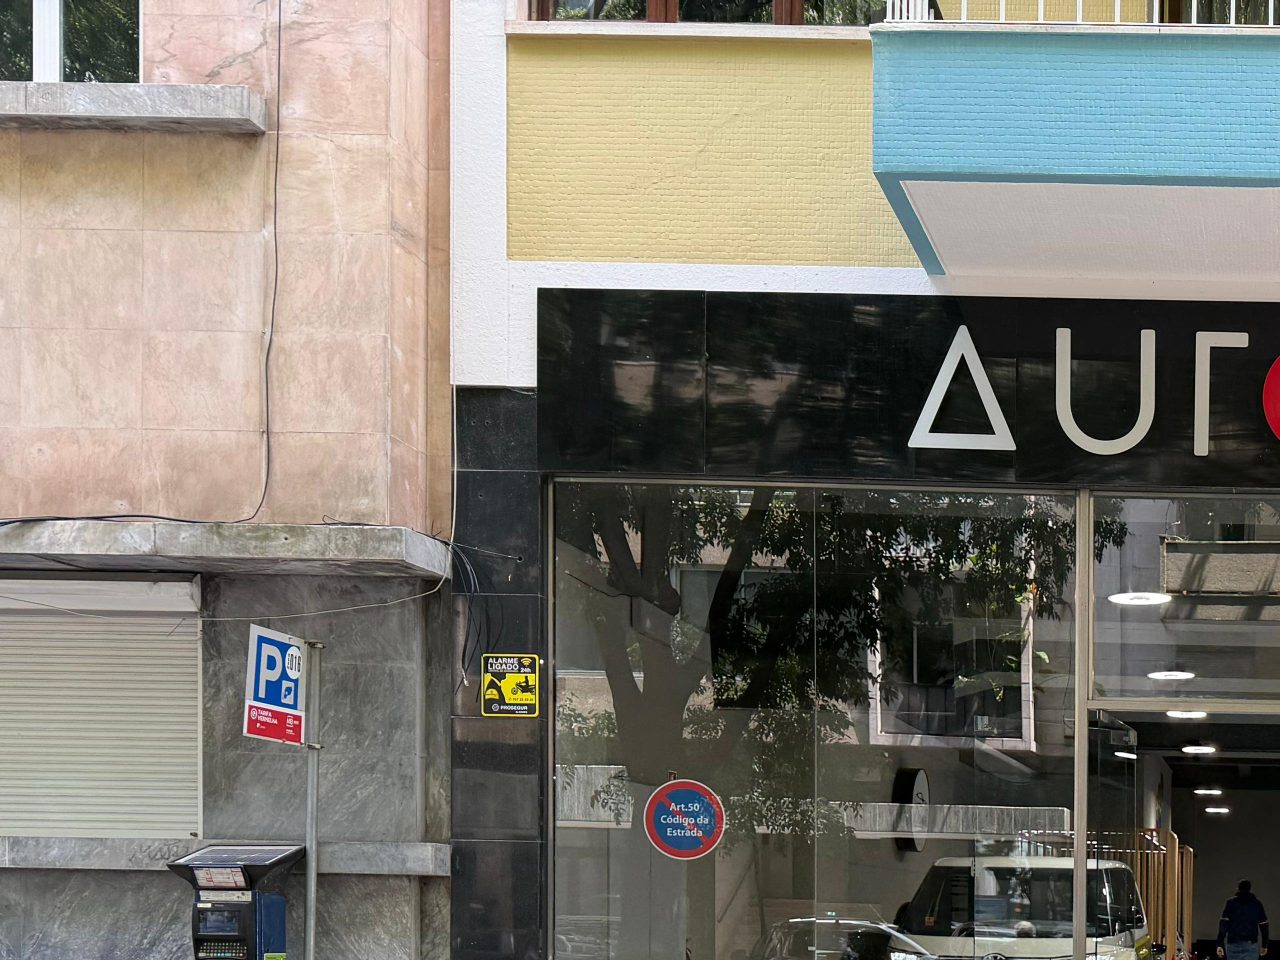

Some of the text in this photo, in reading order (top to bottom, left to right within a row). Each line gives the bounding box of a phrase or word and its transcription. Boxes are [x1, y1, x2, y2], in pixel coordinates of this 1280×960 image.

[258, 643, 283, 698] P
[669, 802, 700, 812] Art.50
[660, 815, 709, 826] Código da
[666, 827, 703, 837] Estrada
